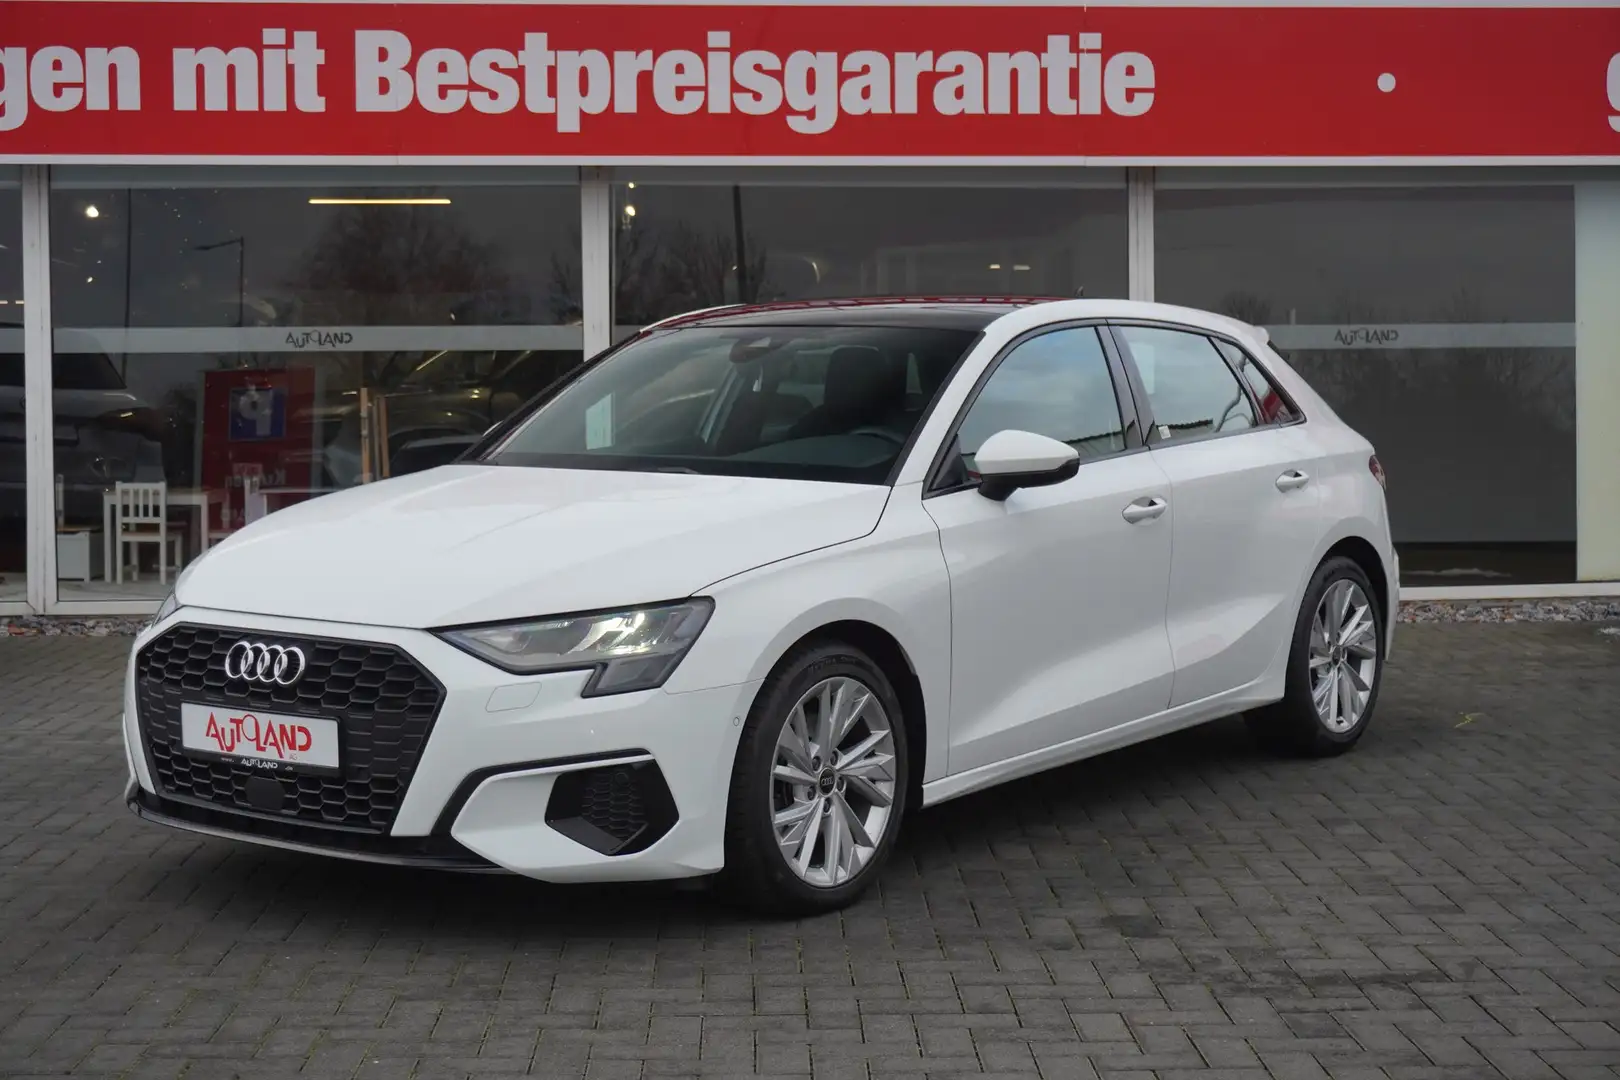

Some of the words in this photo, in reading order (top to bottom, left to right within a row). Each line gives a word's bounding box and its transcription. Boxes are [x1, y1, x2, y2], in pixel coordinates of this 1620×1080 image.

[172, 28, 325, 112] mit
[354, 29, 1155, 134] Bestpreisgarantie
[206, 712, 312, 758] AUTOLAND
